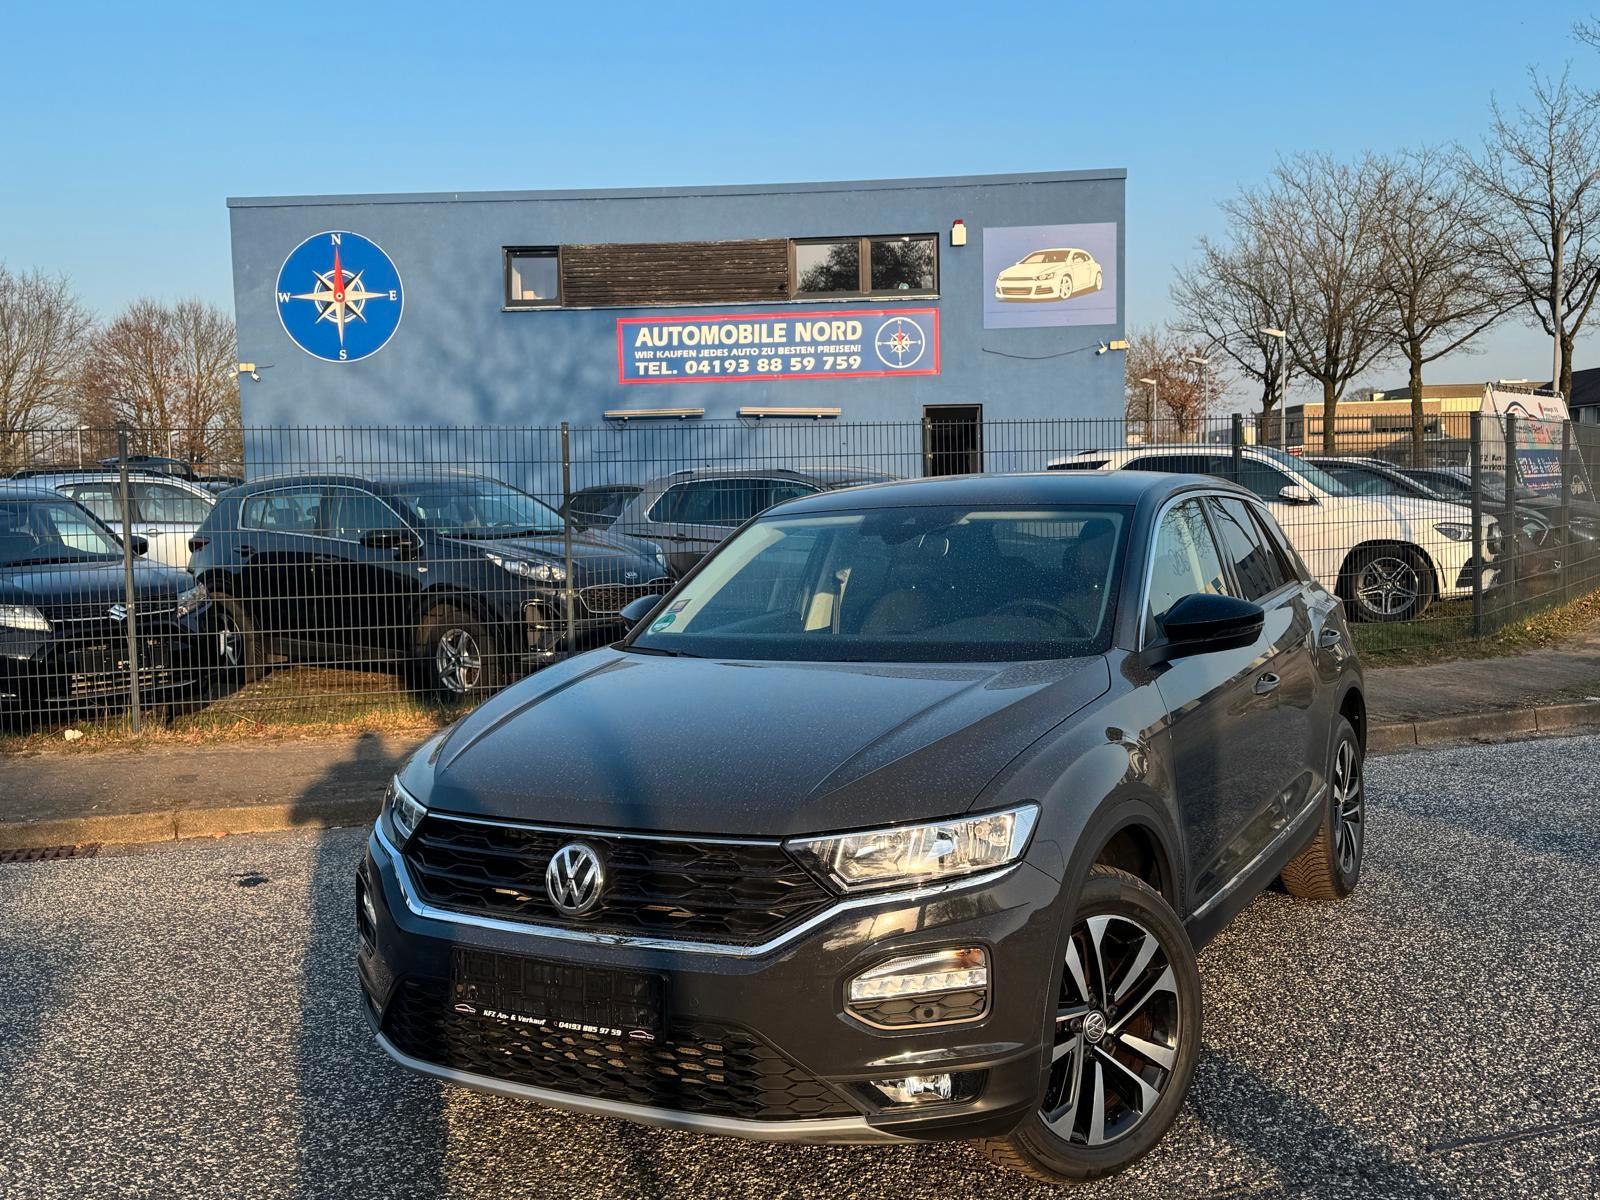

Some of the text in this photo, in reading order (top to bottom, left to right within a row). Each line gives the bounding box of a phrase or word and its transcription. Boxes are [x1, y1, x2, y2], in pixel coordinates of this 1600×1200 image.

[331, 234, 341, 245] N
[278, 292, 291, 303] W
[389, 290, 397, 301] E
[634, 320, 863, 347] AUTOMOBILE NORD
[339, 349, 347, 360] S
[635, 344, 861, 359] WIR KAUFEN JEDES AUTO ZU BESTEN PREISEN!
[635, 355, 862, 375] TEL. 04193 88 59 759
[546, 845, 603, 914] VW
[483, 1009, 496, 1018] KFZ
[497, 1012, 509, 1020] An-
[518, 1015, 547, 1025] Verkauf
[558, 1021, 581, 1031] 04193
